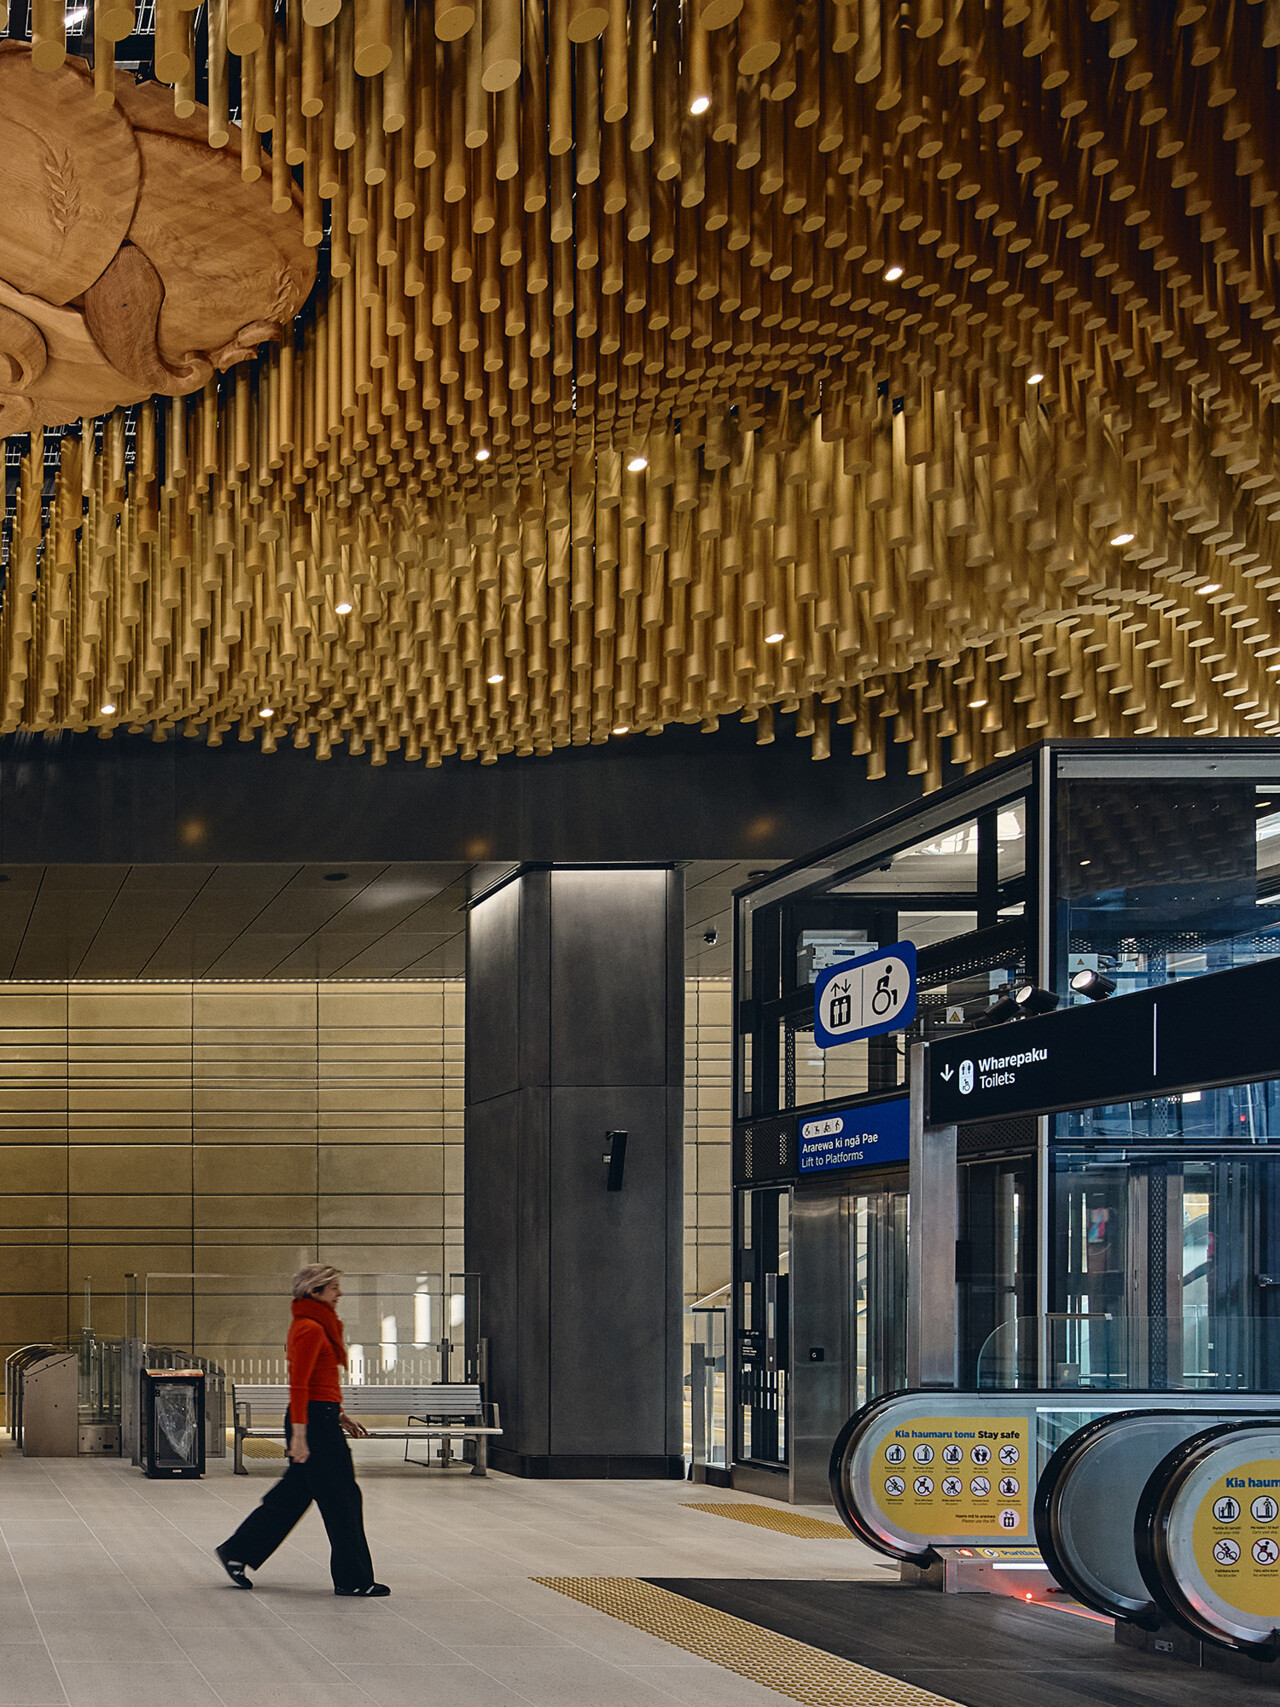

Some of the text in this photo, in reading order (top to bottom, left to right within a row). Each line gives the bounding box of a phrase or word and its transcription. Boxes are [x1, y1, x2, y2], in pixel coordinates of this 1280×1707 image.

[978, 1047, 1048, 1073] Wharepaku
[979, 1072, 1016, 1089] Toilets
[802, 1133, 879, 1154] Ararewa ki ngā Pae
[801, 1150, 864, 1168] Lift to Platforms
[895, 1430, 1020, 1440] Kia haumaru tonu Stay safe
[1225, 1477, 1246, 1488] Kia
